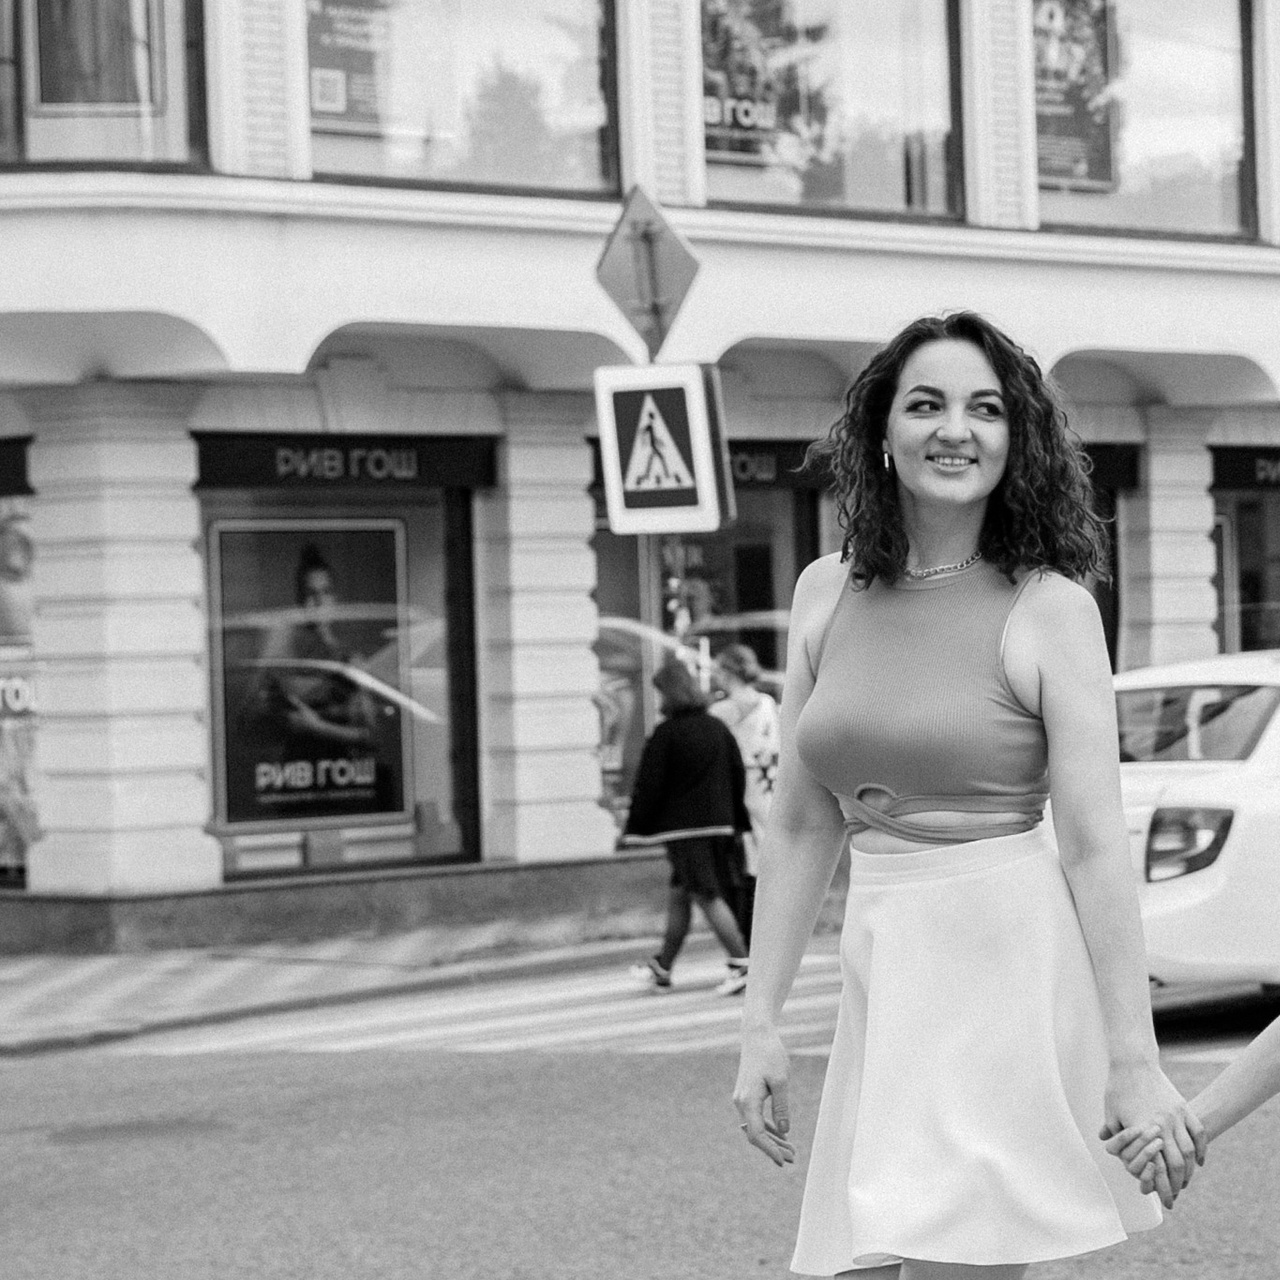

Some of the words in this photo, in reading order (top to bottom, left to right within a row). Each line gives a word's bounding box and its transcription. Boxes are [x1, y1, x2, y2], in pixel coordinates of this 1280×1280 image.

[275, 448, 344, 480] РИВ
[350, 448, 418, 480] ГОШ
[255, 762, 313, 790] РИВ
[317, 757, 376, 788] ГОШ
